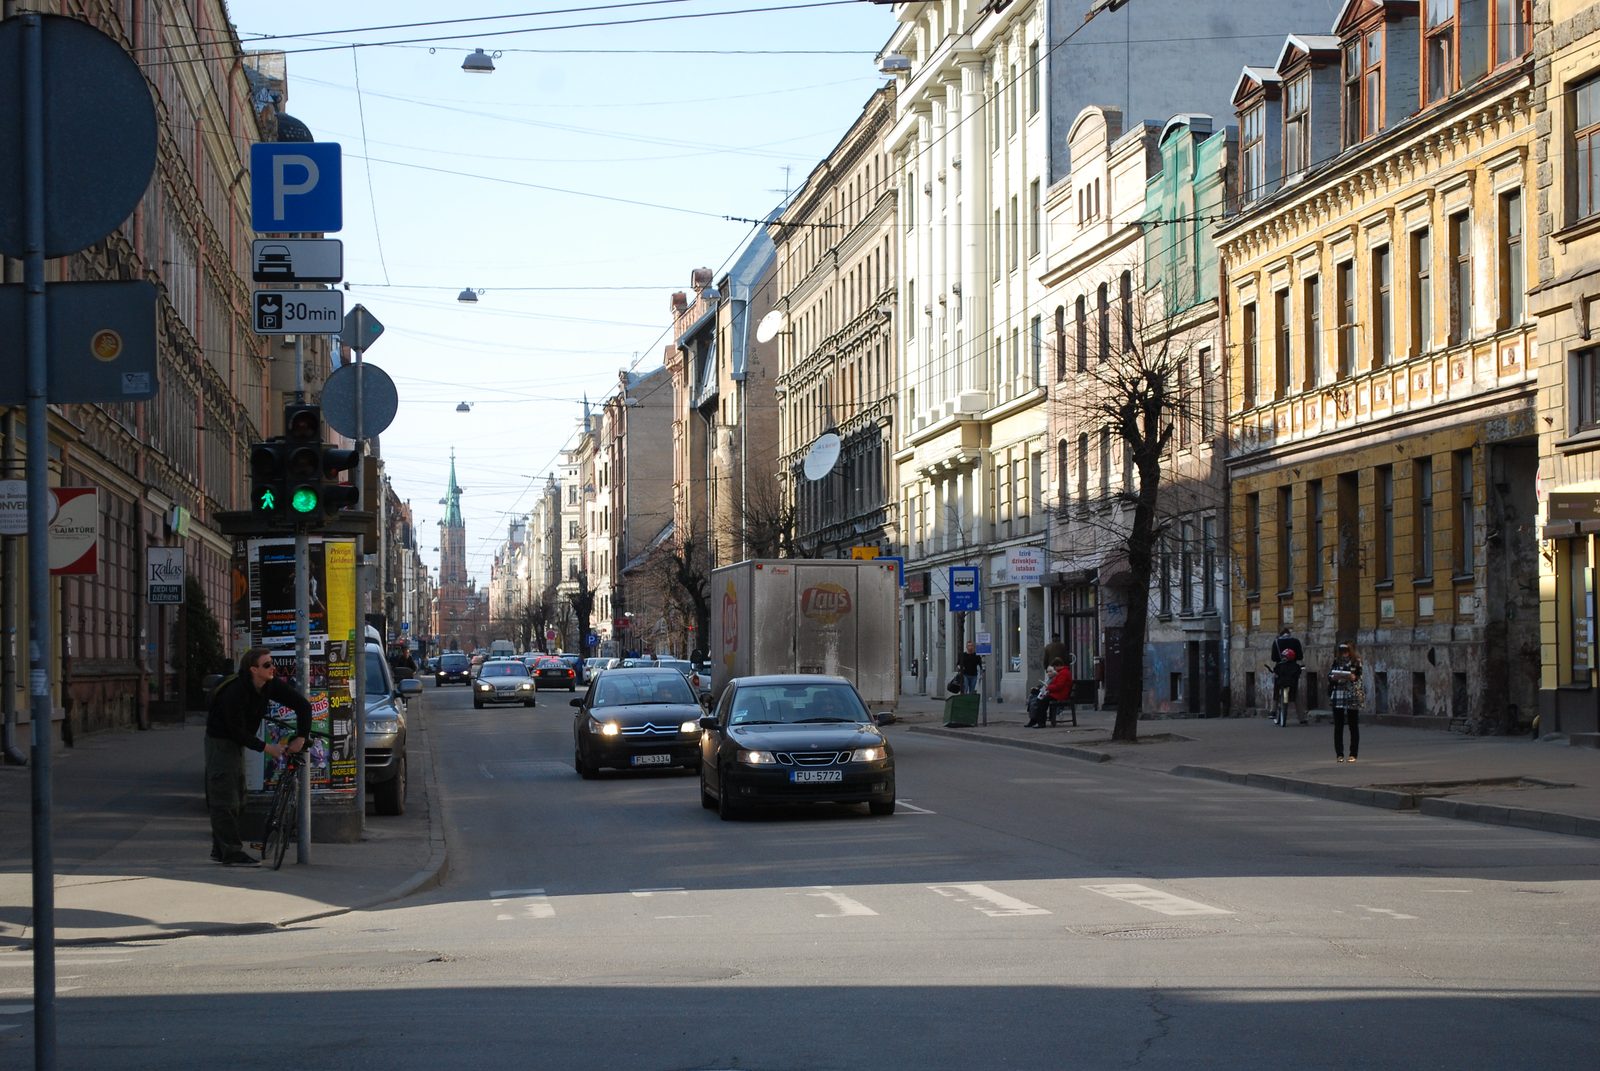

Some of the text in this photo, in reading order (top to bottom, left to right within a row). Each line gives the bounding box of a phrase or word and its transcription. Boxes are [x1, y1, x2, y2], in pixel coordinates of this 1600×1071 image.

[272, 154, 320, 221] P
[284, 302, 337, 321] 30min
[149, 558, 183, 583] Kallas
[330, 696, 340, 708] 30
[636, 755, 670, 765] FL-3334
[796, 771, 841, 782] FU-5772
